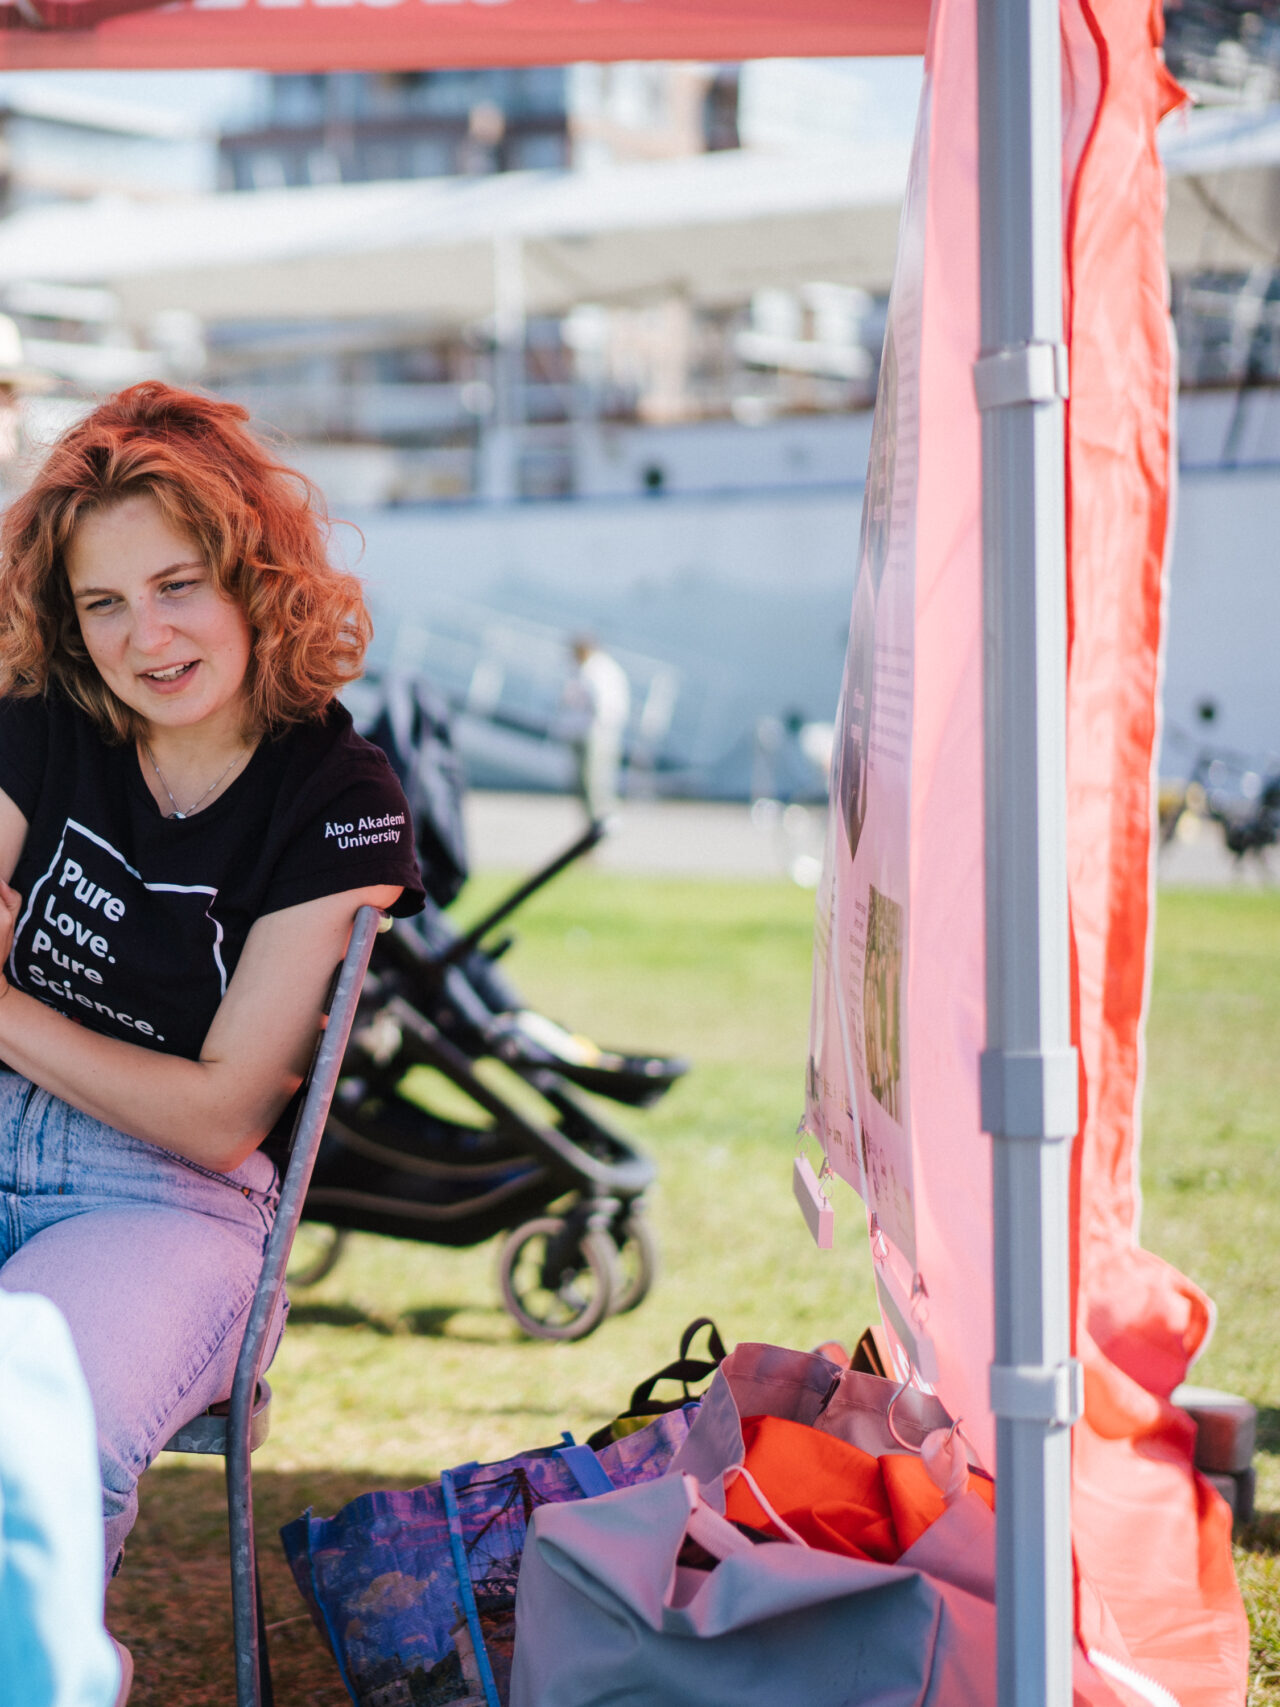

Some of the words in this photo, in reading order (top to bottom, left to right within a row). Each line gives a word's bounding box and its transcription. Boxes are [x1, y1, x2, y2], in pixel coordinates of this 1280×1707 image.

[324, 822, 354, 838] Åbo
[358, 812, 405, 831] Akademi
[338, 829, 401, 849] University
[58, 858, 126, 922] Pure
[31, 929, 104, 985] Pure
[43, 894, 116, 964] Love.
[28, 964, 165, 1042] Science.
